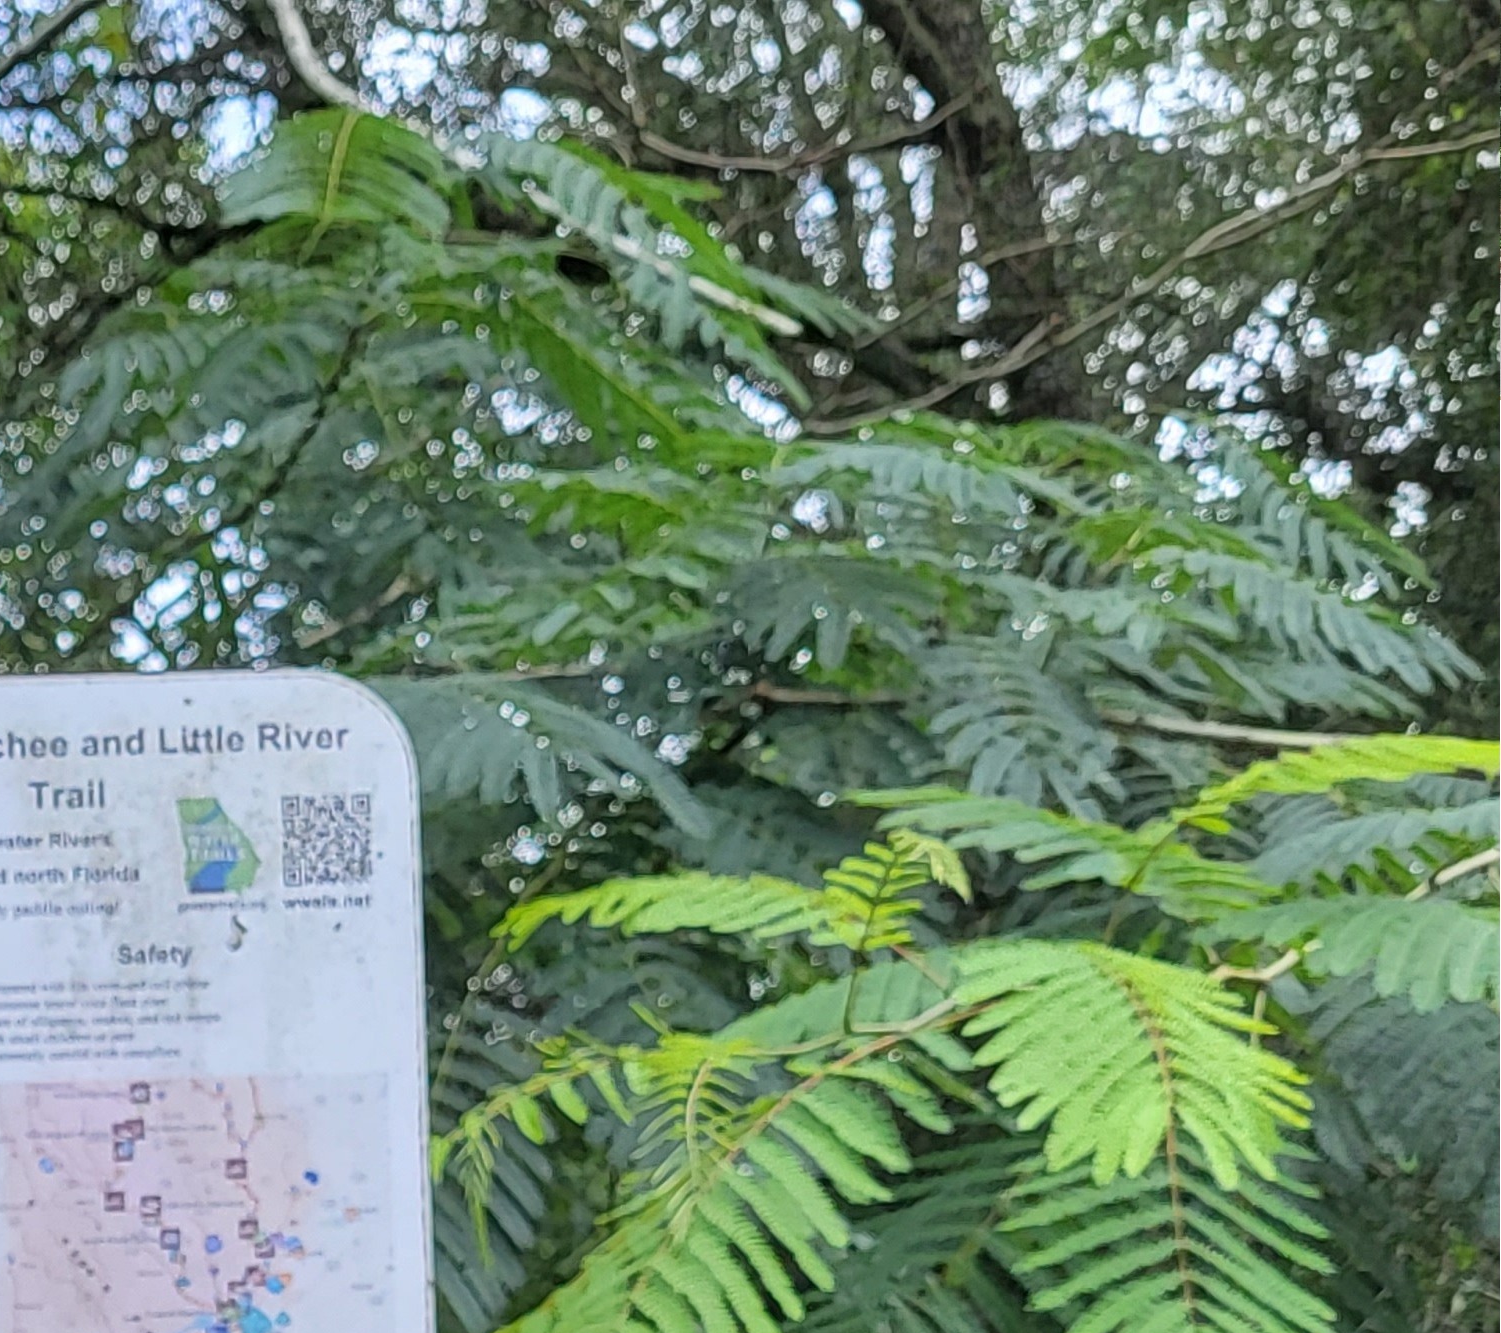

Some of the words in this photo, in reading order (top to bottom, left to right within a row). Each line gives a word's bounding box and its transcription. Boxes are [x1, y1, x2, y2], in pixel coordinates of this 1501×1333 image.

[81, 728, 145, 756] and
[159, 725, 244, 754] Little
[258, 723, 349, 751] River
[29, 779, 105, 809] Trail
[14, 867, 64, 884] north
[72, 865, 140, 883] Florida
[118, 943, 192, 968] Safety
